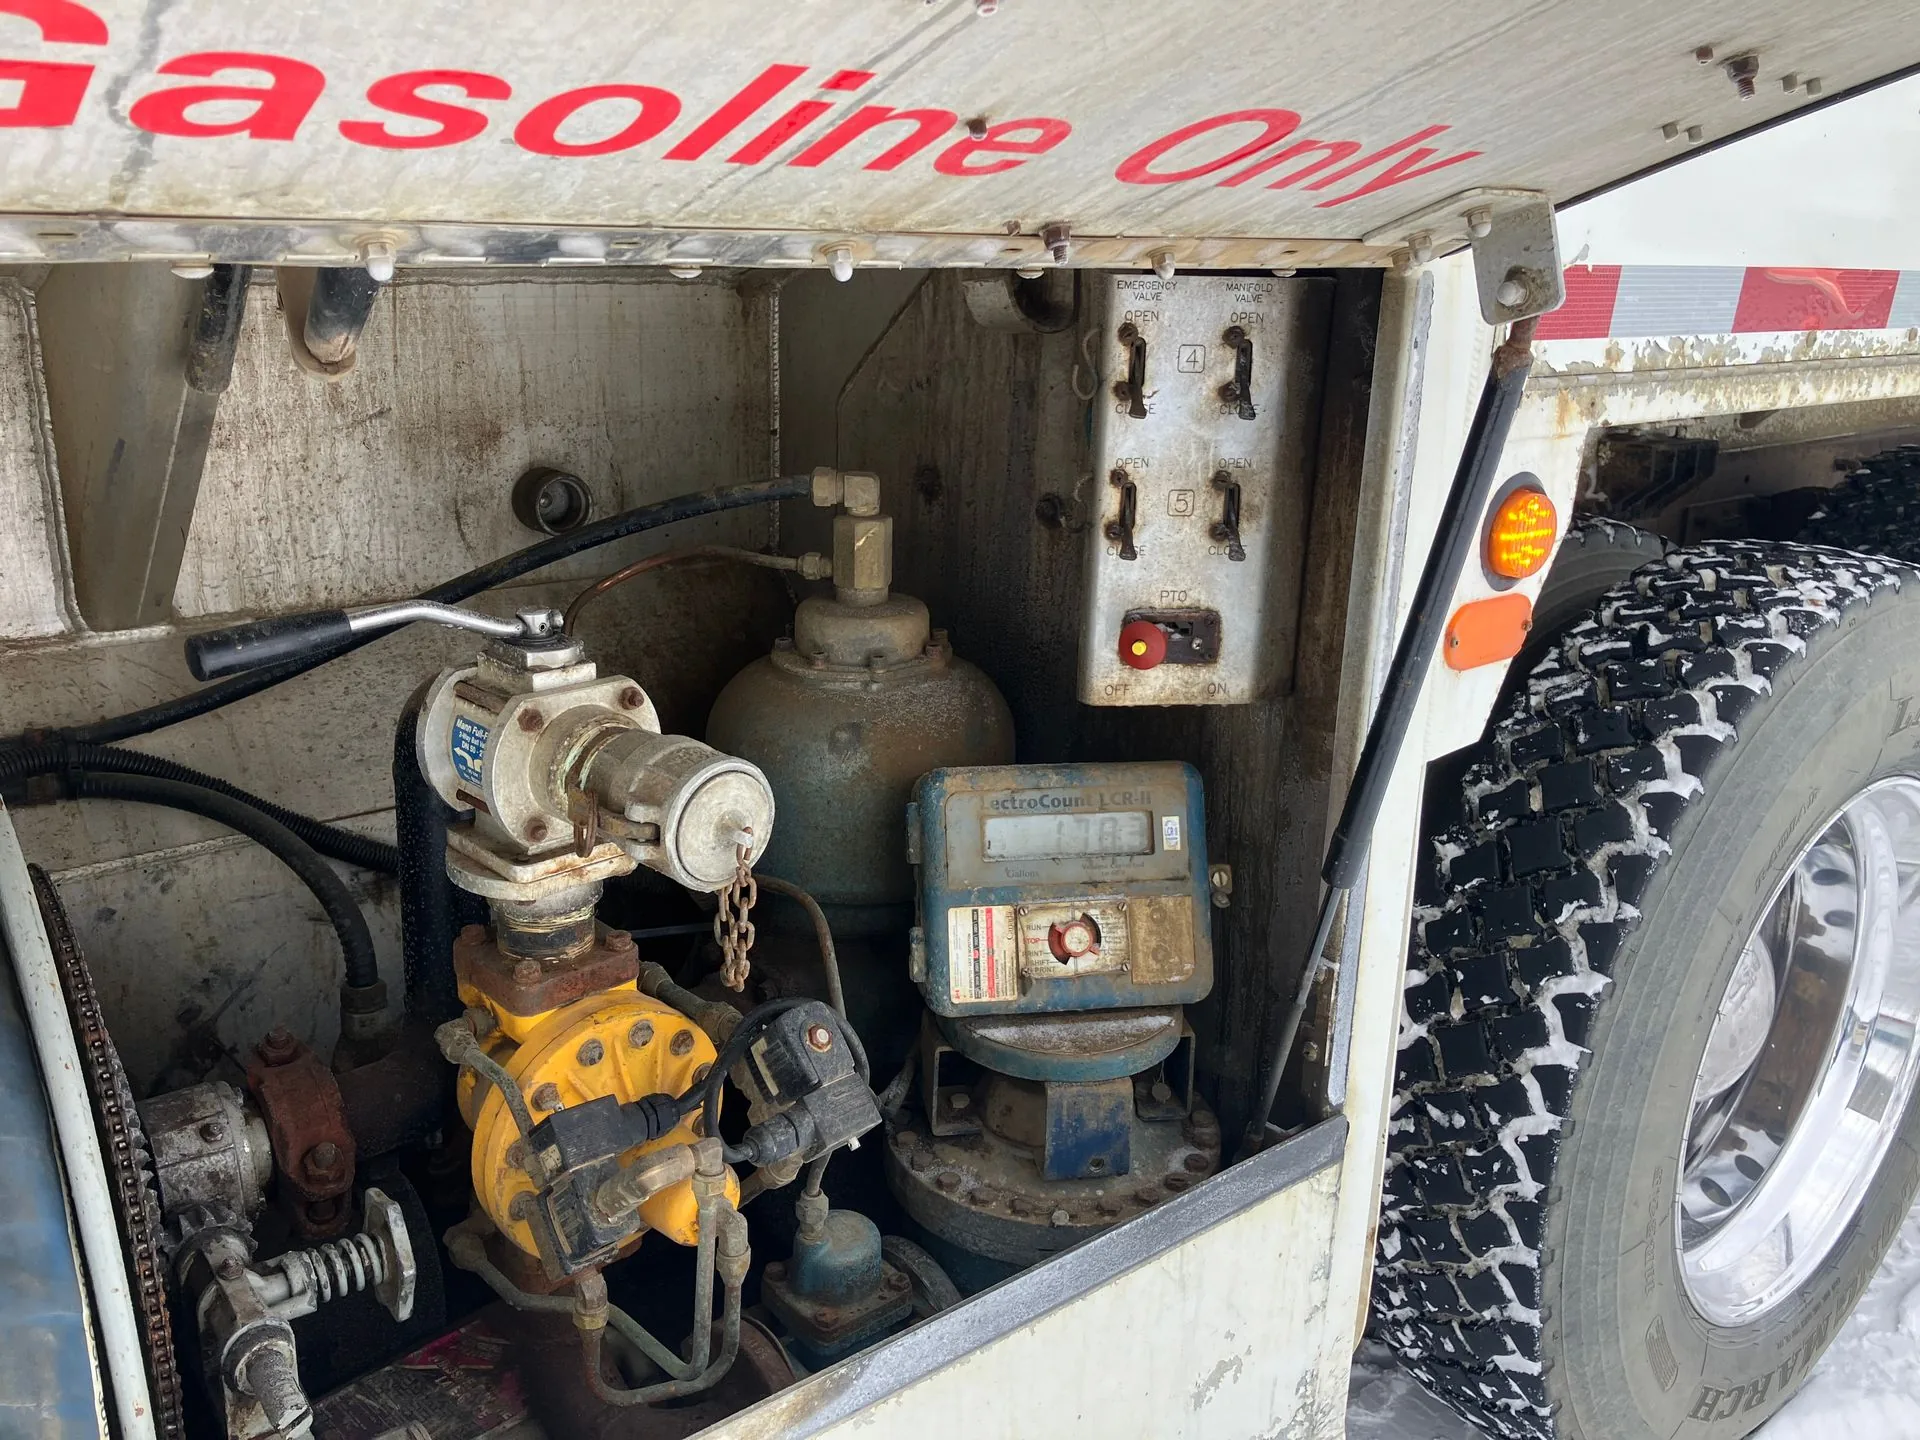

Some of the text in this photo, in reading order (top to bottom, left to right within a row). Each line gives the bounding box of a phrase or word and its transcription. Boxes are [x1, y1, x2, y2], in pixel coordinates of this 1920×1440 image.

[1114, 108, 1484, 208] Only
[1117, 280, 1177, 290] EMERGENCY
[1225, 283, 1273, 293] MANIFOLD
[1132, 291, 1163, 301] VALVE
[1234, 293, 1263, 304] VALVE
[1124, 310, 1160, 322] OPEN
[1230, 312, 1265, 324] OPEN
[1185, 349, 1199, 369] 4
[1115, 403, 1156, 415] CLE
[1219, 403, 1260, 416] CLOE
[1115, 457, 1150, 469] OPEN
[1218, 457, 1252, 469] OPEN
[1174, 493, 1188, 513] 5
[1106, 545, 1146, 557] CLSE
[1208, 545, 1248, 556] CLO
[1160, 589, 1188, 603] PTO
[1104, 684, 1131, 697] OFF
[1207, 682, 1227, 696] ON
[1687, 1311, 1832, 1423] MARCH
